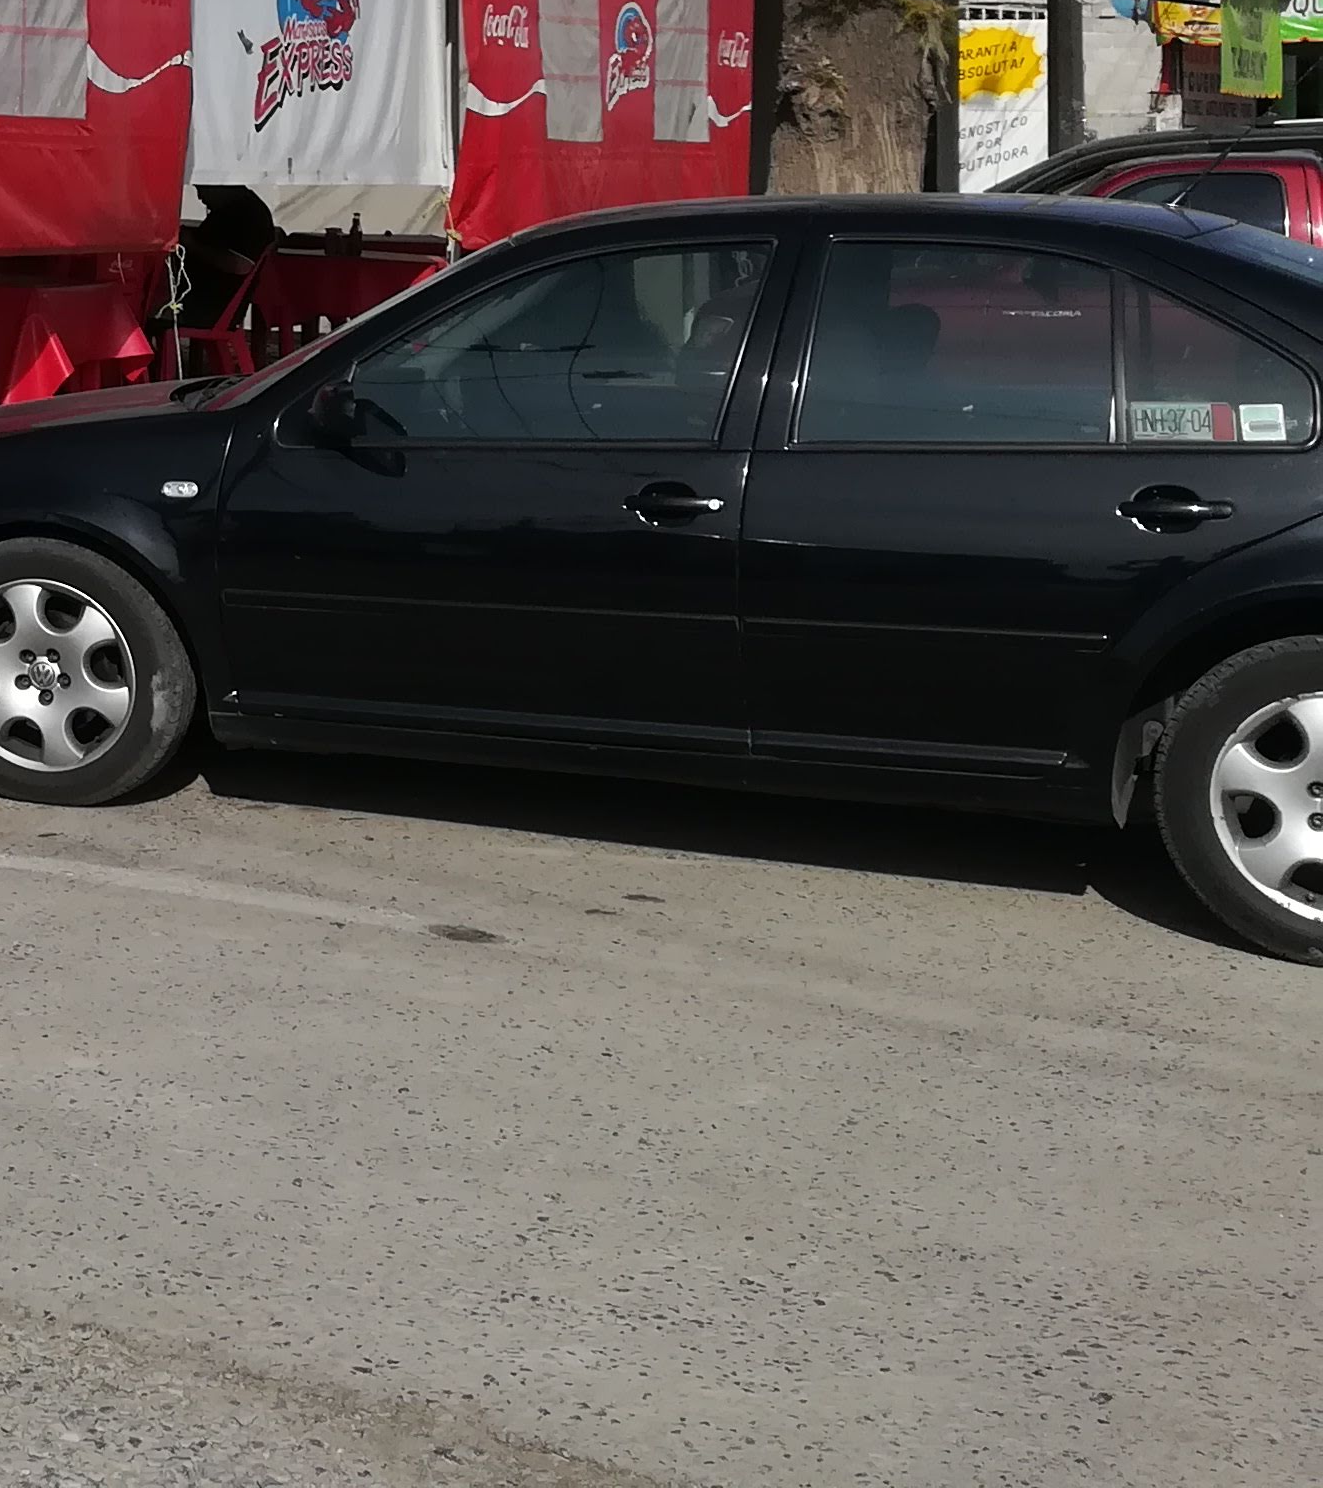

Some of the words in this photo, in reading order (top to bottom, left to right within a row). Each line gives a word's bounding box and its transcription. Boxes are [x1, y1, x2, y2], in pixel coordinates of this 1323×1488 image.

[958, 40, 1018, 61] ARANTIA
[958, 57, 1026, 81] BSOLUTA!
[254, 37, 354, 133] EXPRESS
[976, 137, 1002, 151] POR
